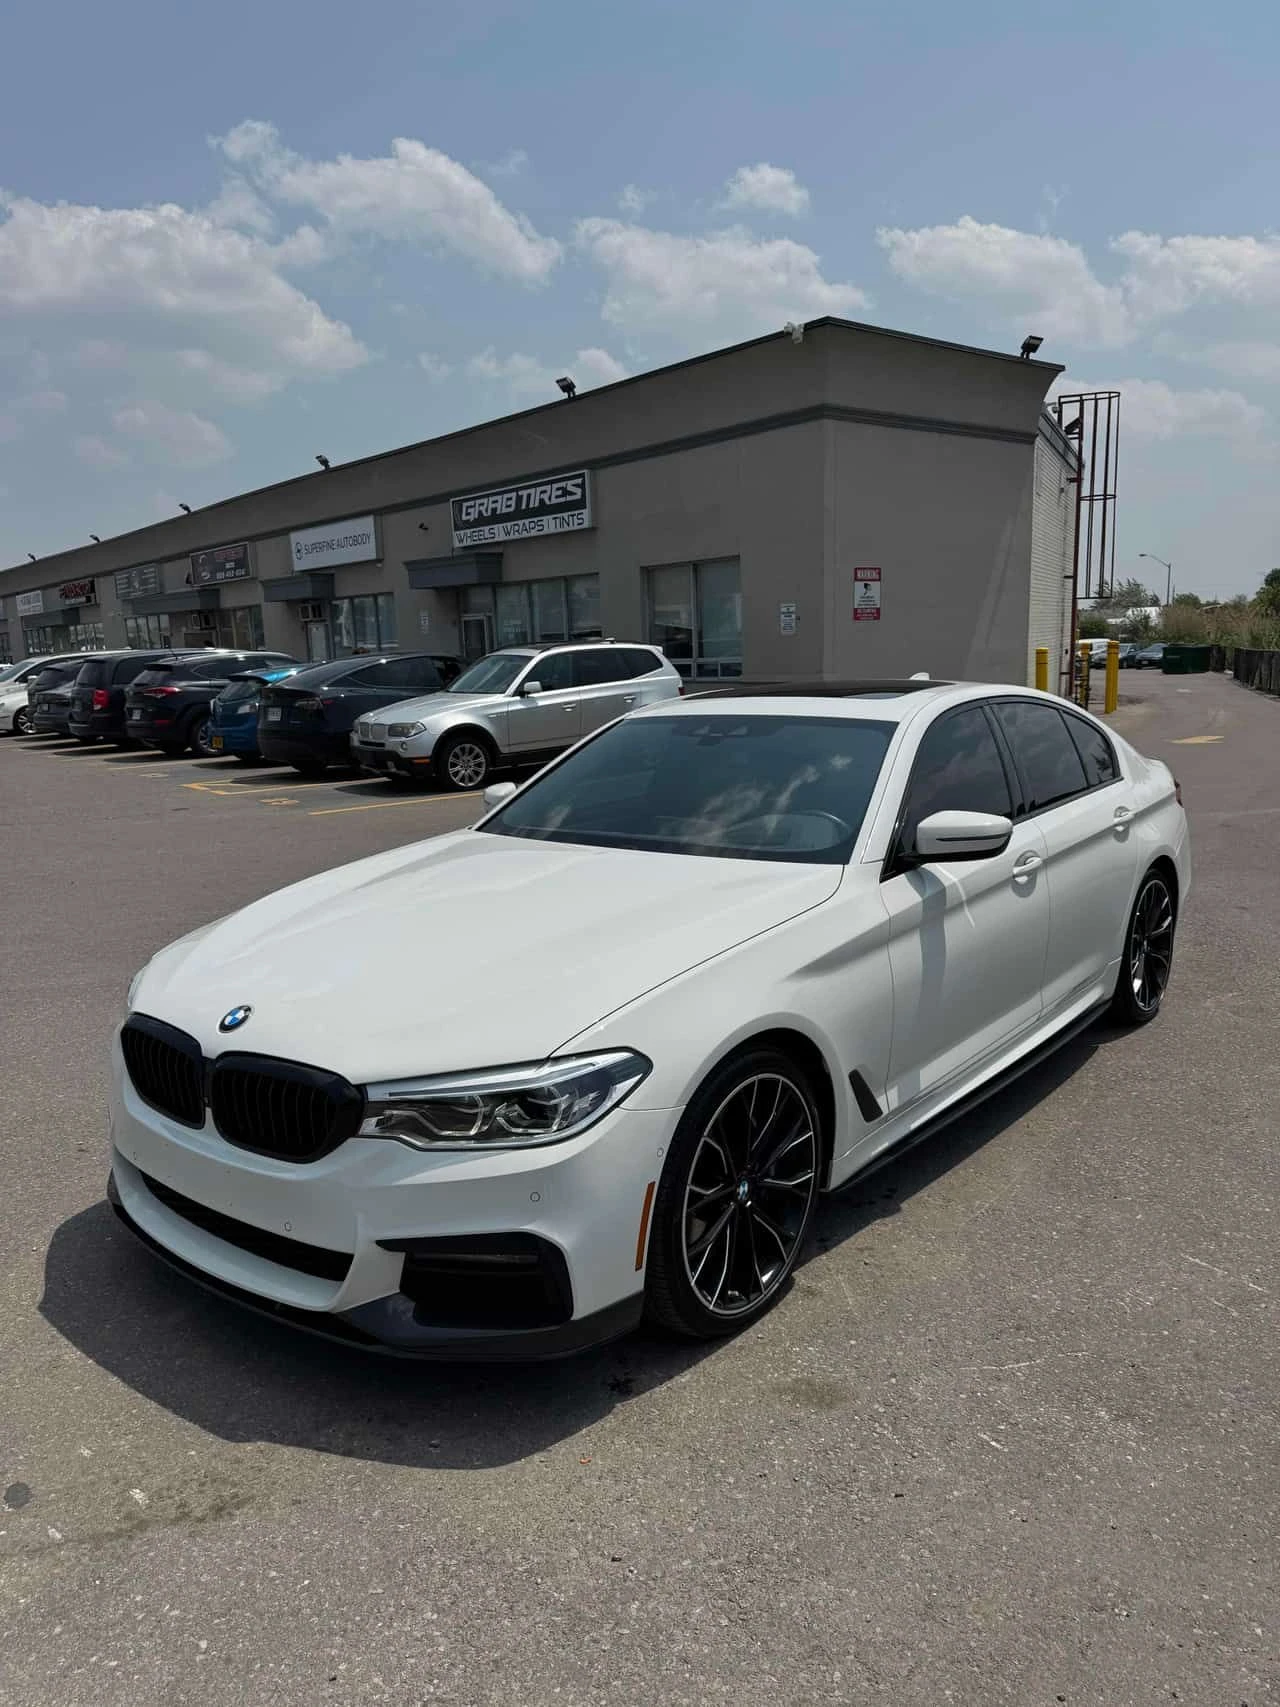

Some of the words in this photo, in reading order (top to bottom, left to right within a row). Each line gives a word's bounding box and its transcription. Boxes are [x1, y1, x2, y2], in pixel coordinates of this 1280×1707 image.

[461, 491, 517, 522] GRAB
[518, 478, 584, 510] TIRES
[304, 538, 336, 555] SUPERFINE
[336, 531, 371, 549] AUTOBODY
[456, 527, 496, 545] WHEELS
[503, 519, 545, 537] WRAPS
[551, 512, 585, 529] TINTS
